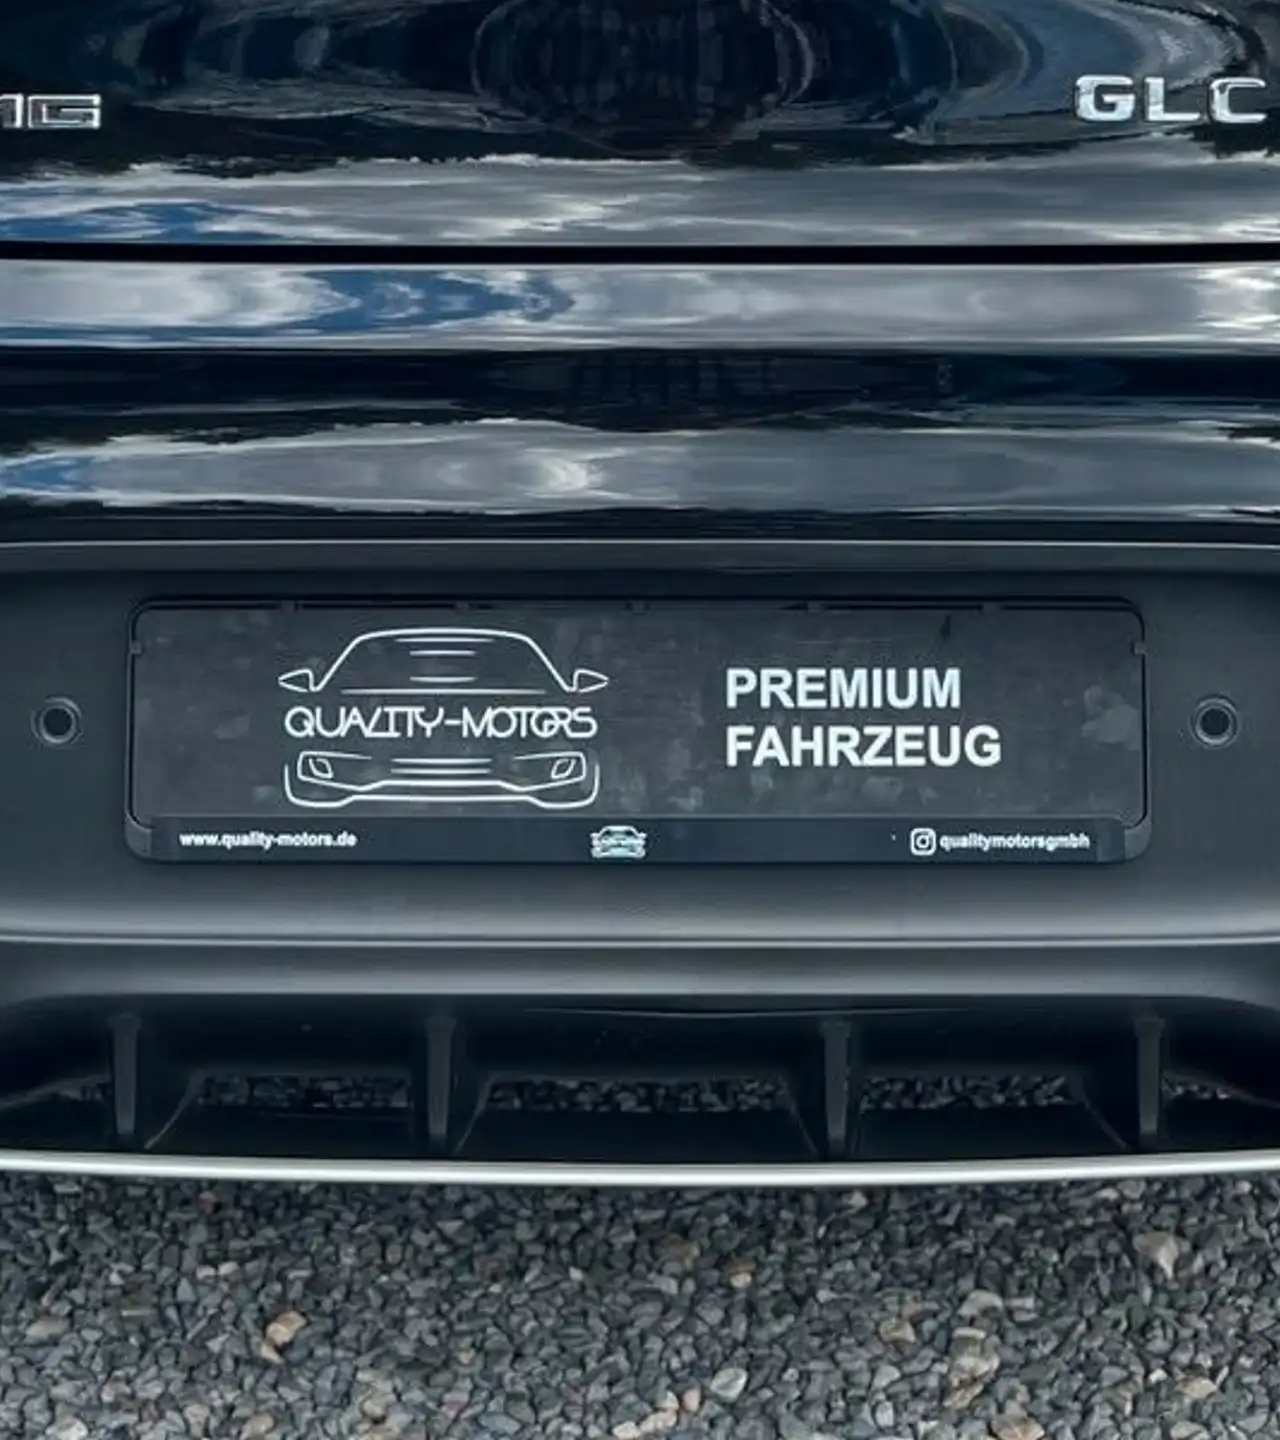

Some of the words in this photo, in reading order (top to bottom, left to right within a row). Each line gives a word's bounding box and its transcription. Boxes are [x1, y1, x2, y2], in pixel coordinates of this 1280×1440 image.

[1073, 73, 1268, 124] GLC
[725, 667, 962, 709] PREMIUM
[283, 705, 599, 739] QUALITY-MOTORS
[725, 723, 1003, 768] FAHRZEUG
[178, 830, 358, 851] www.quality-motors.de
[938, 832, 1091, 853] qualitymotorsgmbh
